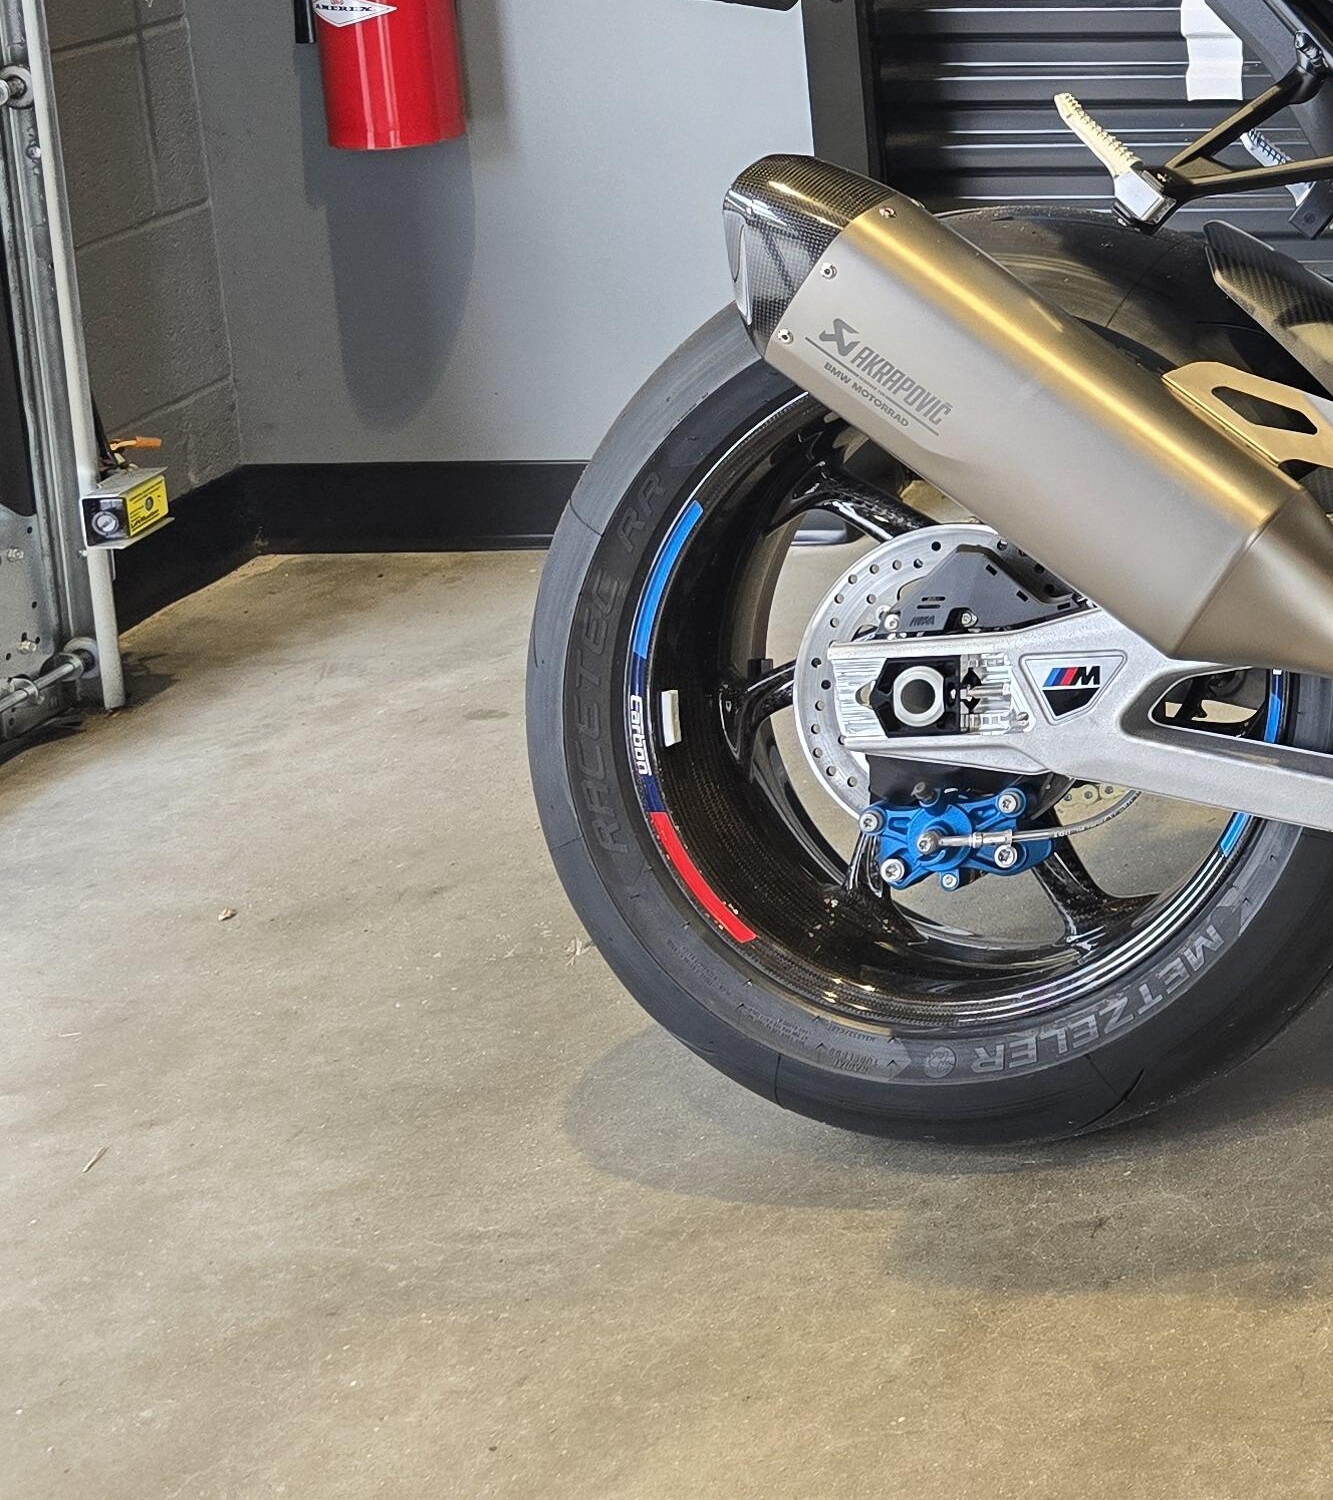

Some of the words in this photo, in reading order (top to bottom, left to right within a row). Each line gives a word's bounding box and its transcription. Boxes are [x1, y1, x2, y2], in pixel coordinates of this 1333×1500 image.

[824, 362, 851, 384] BMW
[852, 381, 909, 427] MOTORRAD
[631, 695, 652, 776] Carbon
[971, 924, 1225, 1073] METZELER
